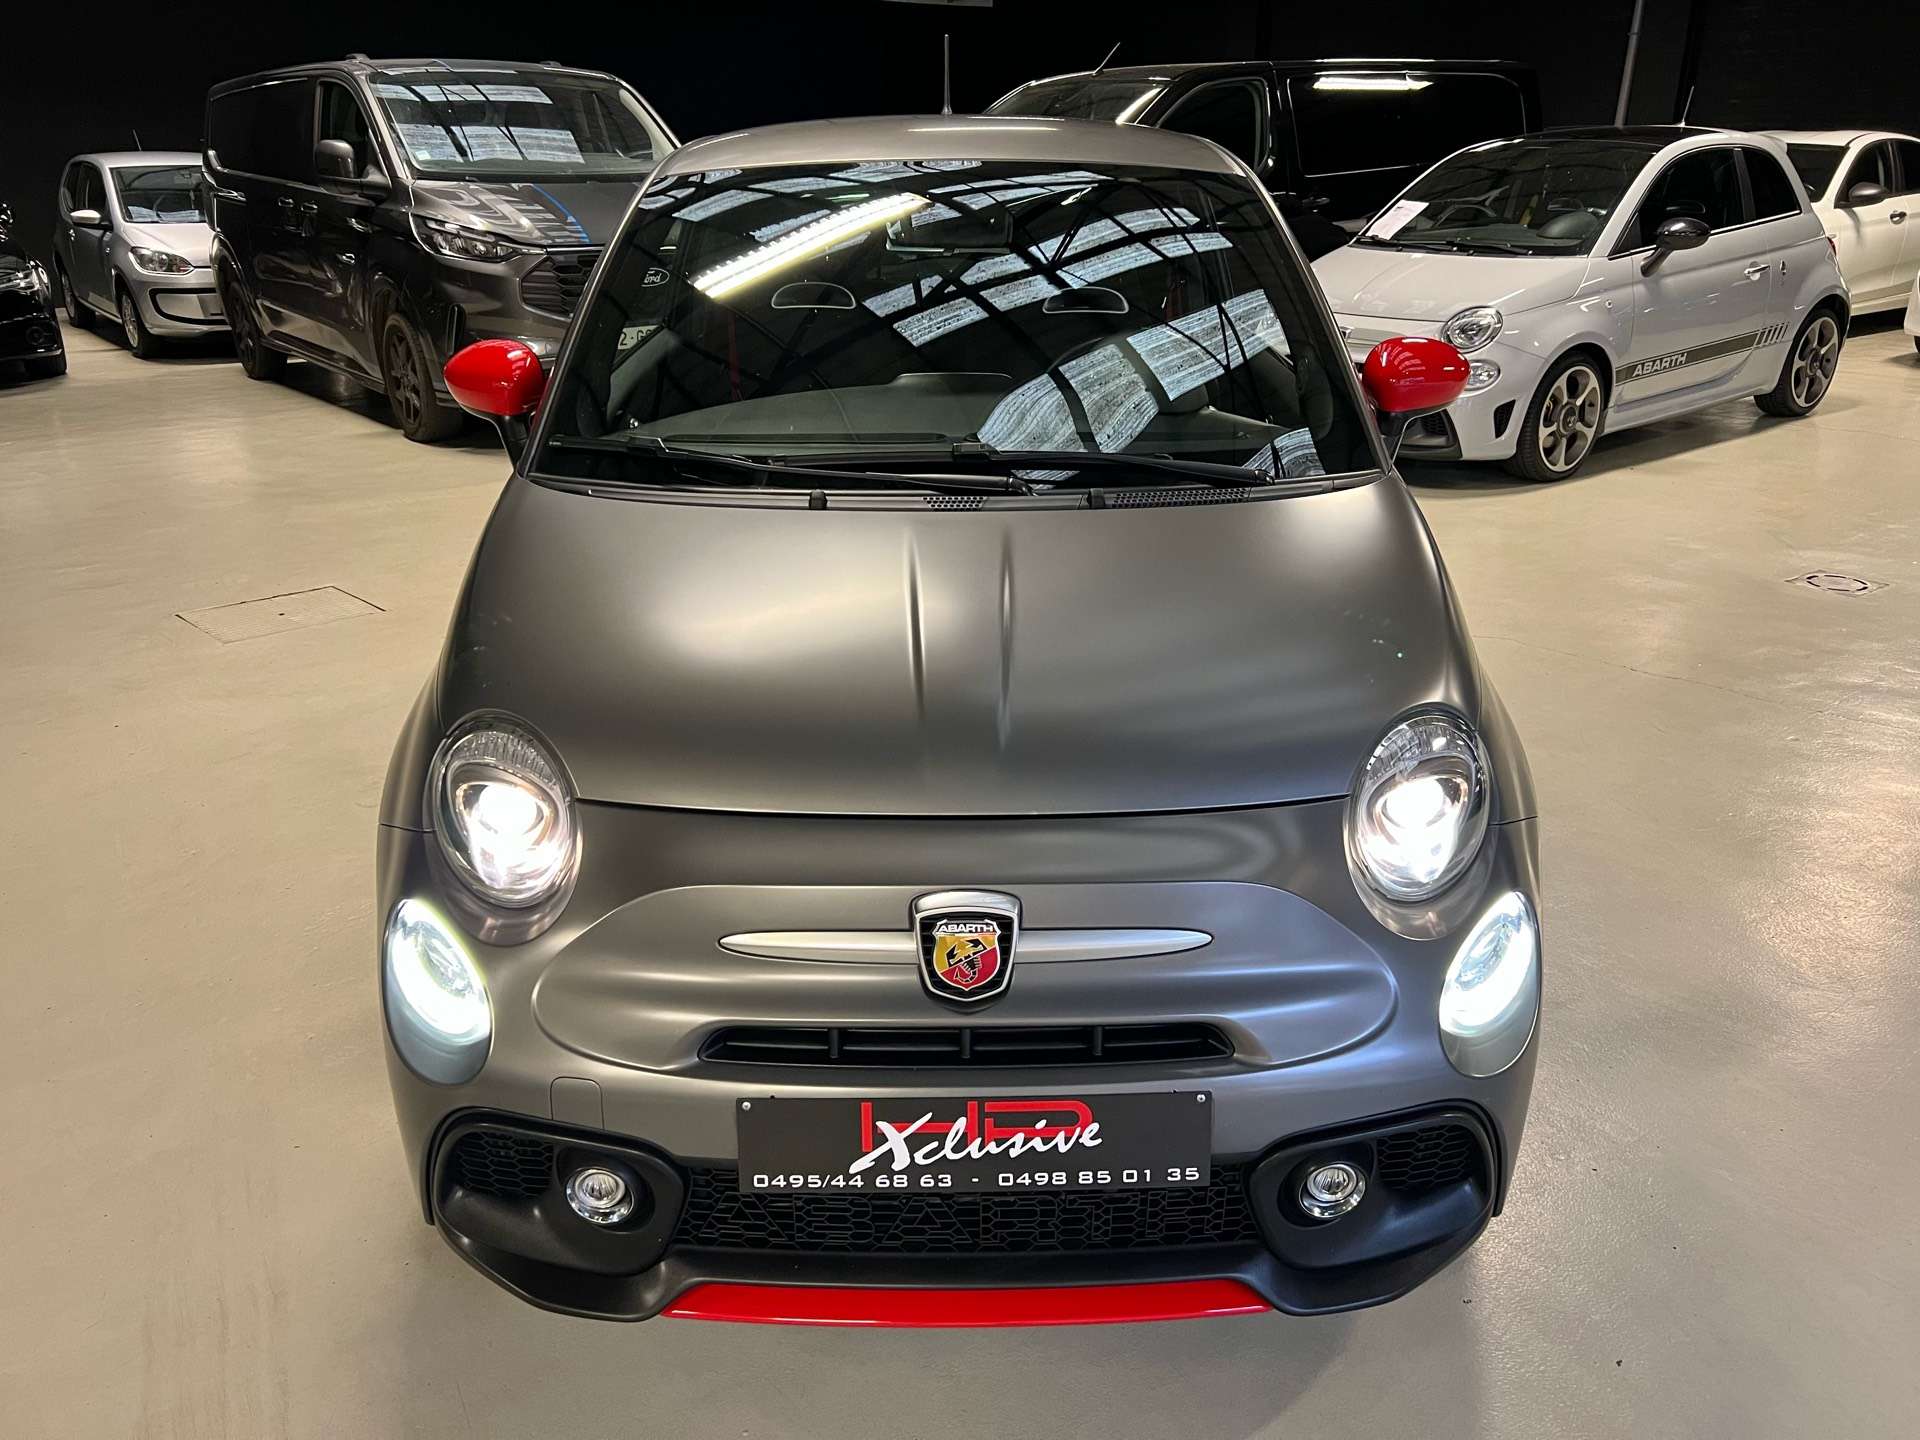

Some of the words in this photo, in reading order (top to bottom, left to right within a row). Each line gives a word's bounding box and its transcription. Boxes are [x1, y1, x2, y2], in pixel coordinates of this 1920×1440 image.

[644, 271, 662, 283] ord
[1631, 352, 1688, 378] ABARTH
[938, 923, 994, 933] ABARTH
[848, 1111, 1103, 1174] Xclusive
[753, 1174, 865, 1188] 0495/44
[875, 1174, 908, 1188] 68
[920, 1174, 952, 1187] 63
[998, 1171, 1067, 1186] 0498
[1078, 1170, 1112, 1184] 85
[1122, 1169, 1151, 1183] 01
[1167, 1167, 1200, 1181] 35
[698, 1187, 1227, 1243] ABARTH
